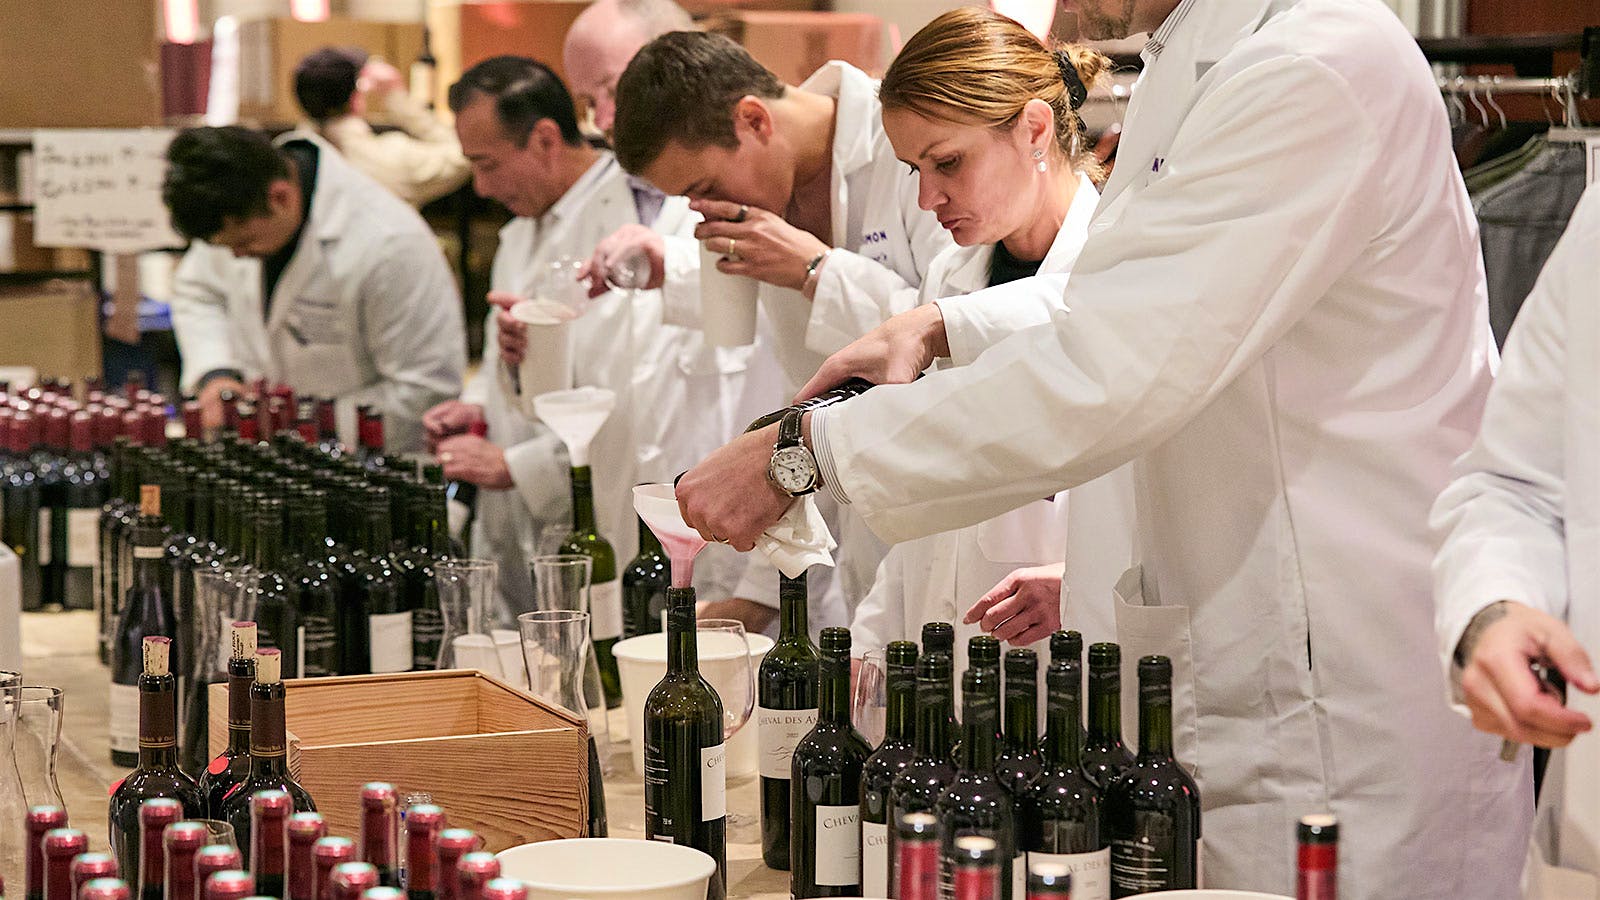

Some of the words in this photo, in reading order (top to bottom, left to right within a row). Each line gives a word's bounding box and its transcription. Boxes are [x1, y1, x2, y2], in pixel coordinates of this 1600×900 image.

[864, 231, 887, 244] MON
[785, 716, 802, 724] DES
[707, 754, 724, 768] CHE
[867, 835, 888, 846] CHE
